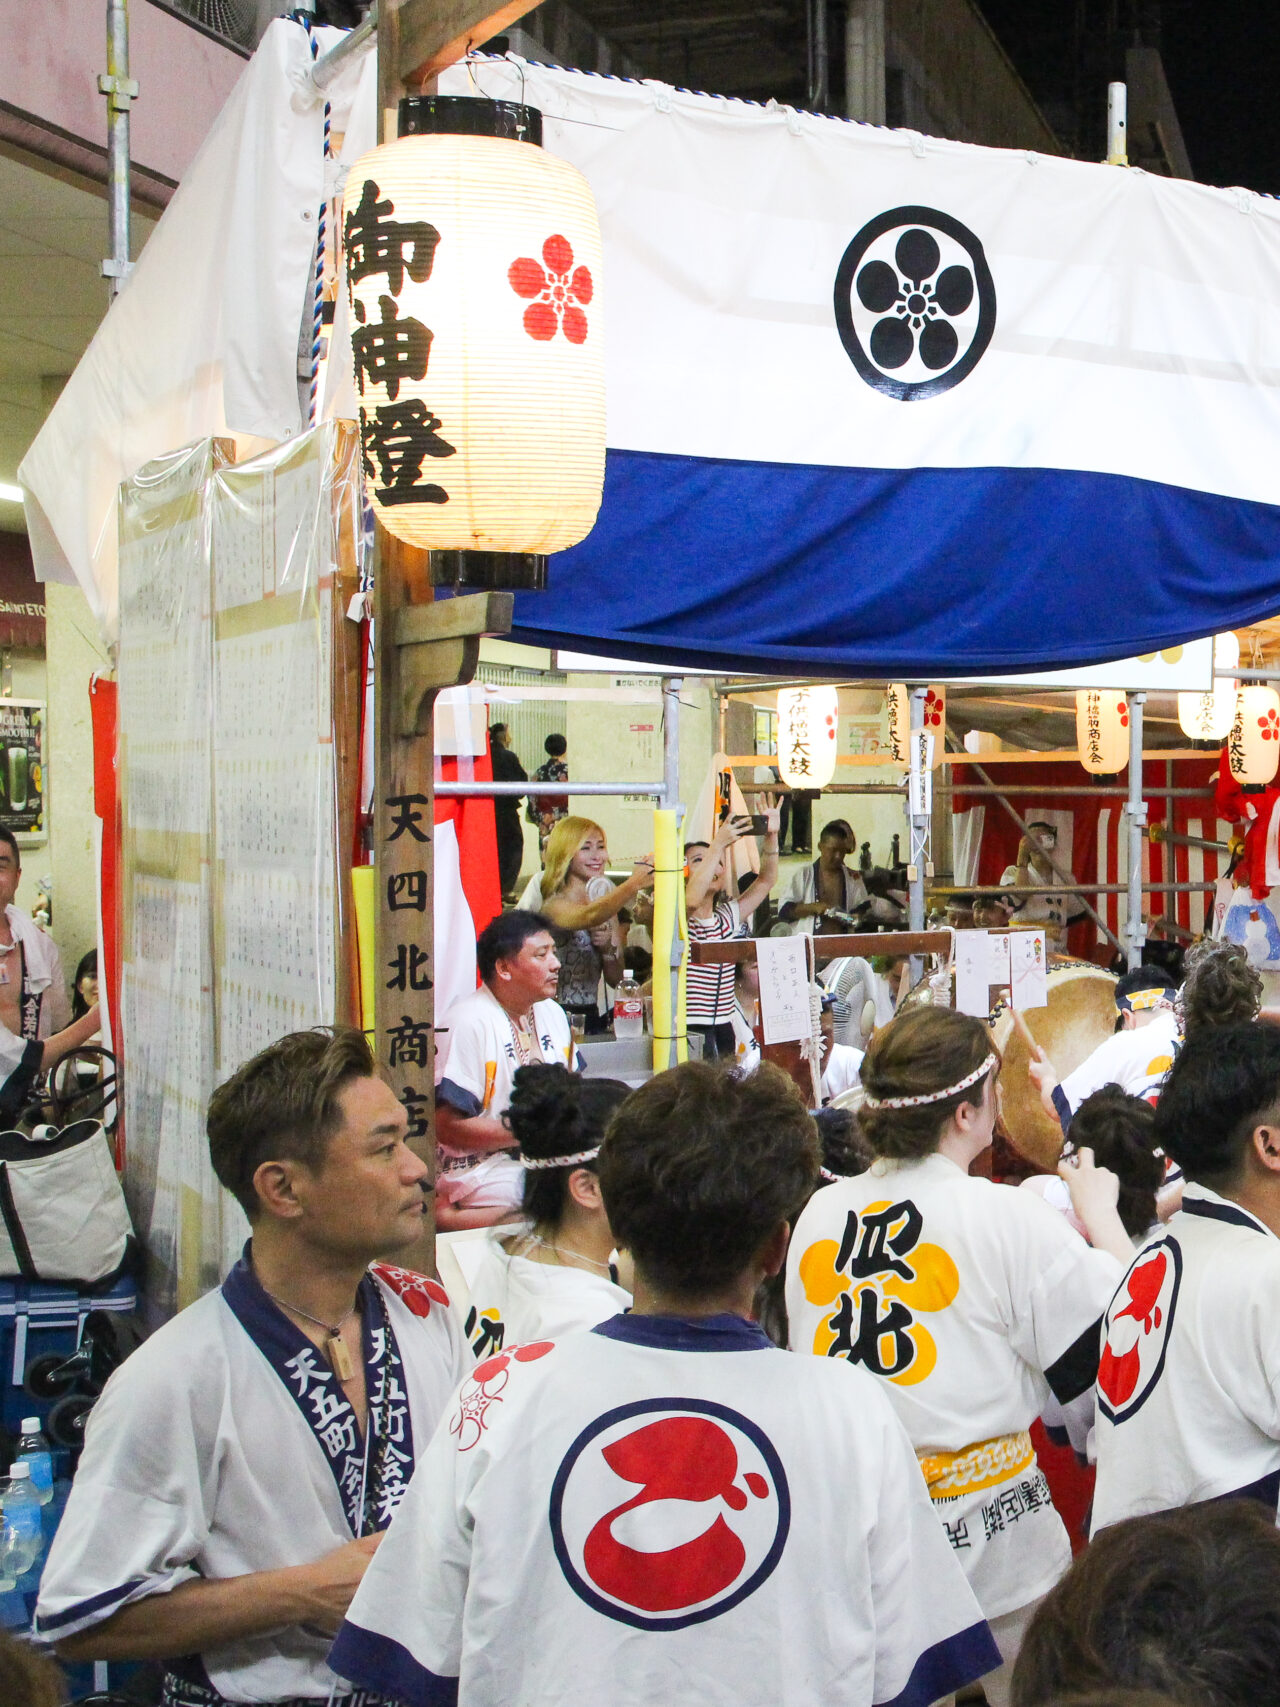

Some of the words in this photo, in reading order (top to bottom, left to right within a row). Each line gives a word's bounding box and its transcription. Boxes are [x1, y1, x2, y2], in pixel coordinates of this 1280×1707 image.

[1087, 690, 1104, 764] 神橋筋商店会
[384, 793, 432, 1214] 天四北商店
